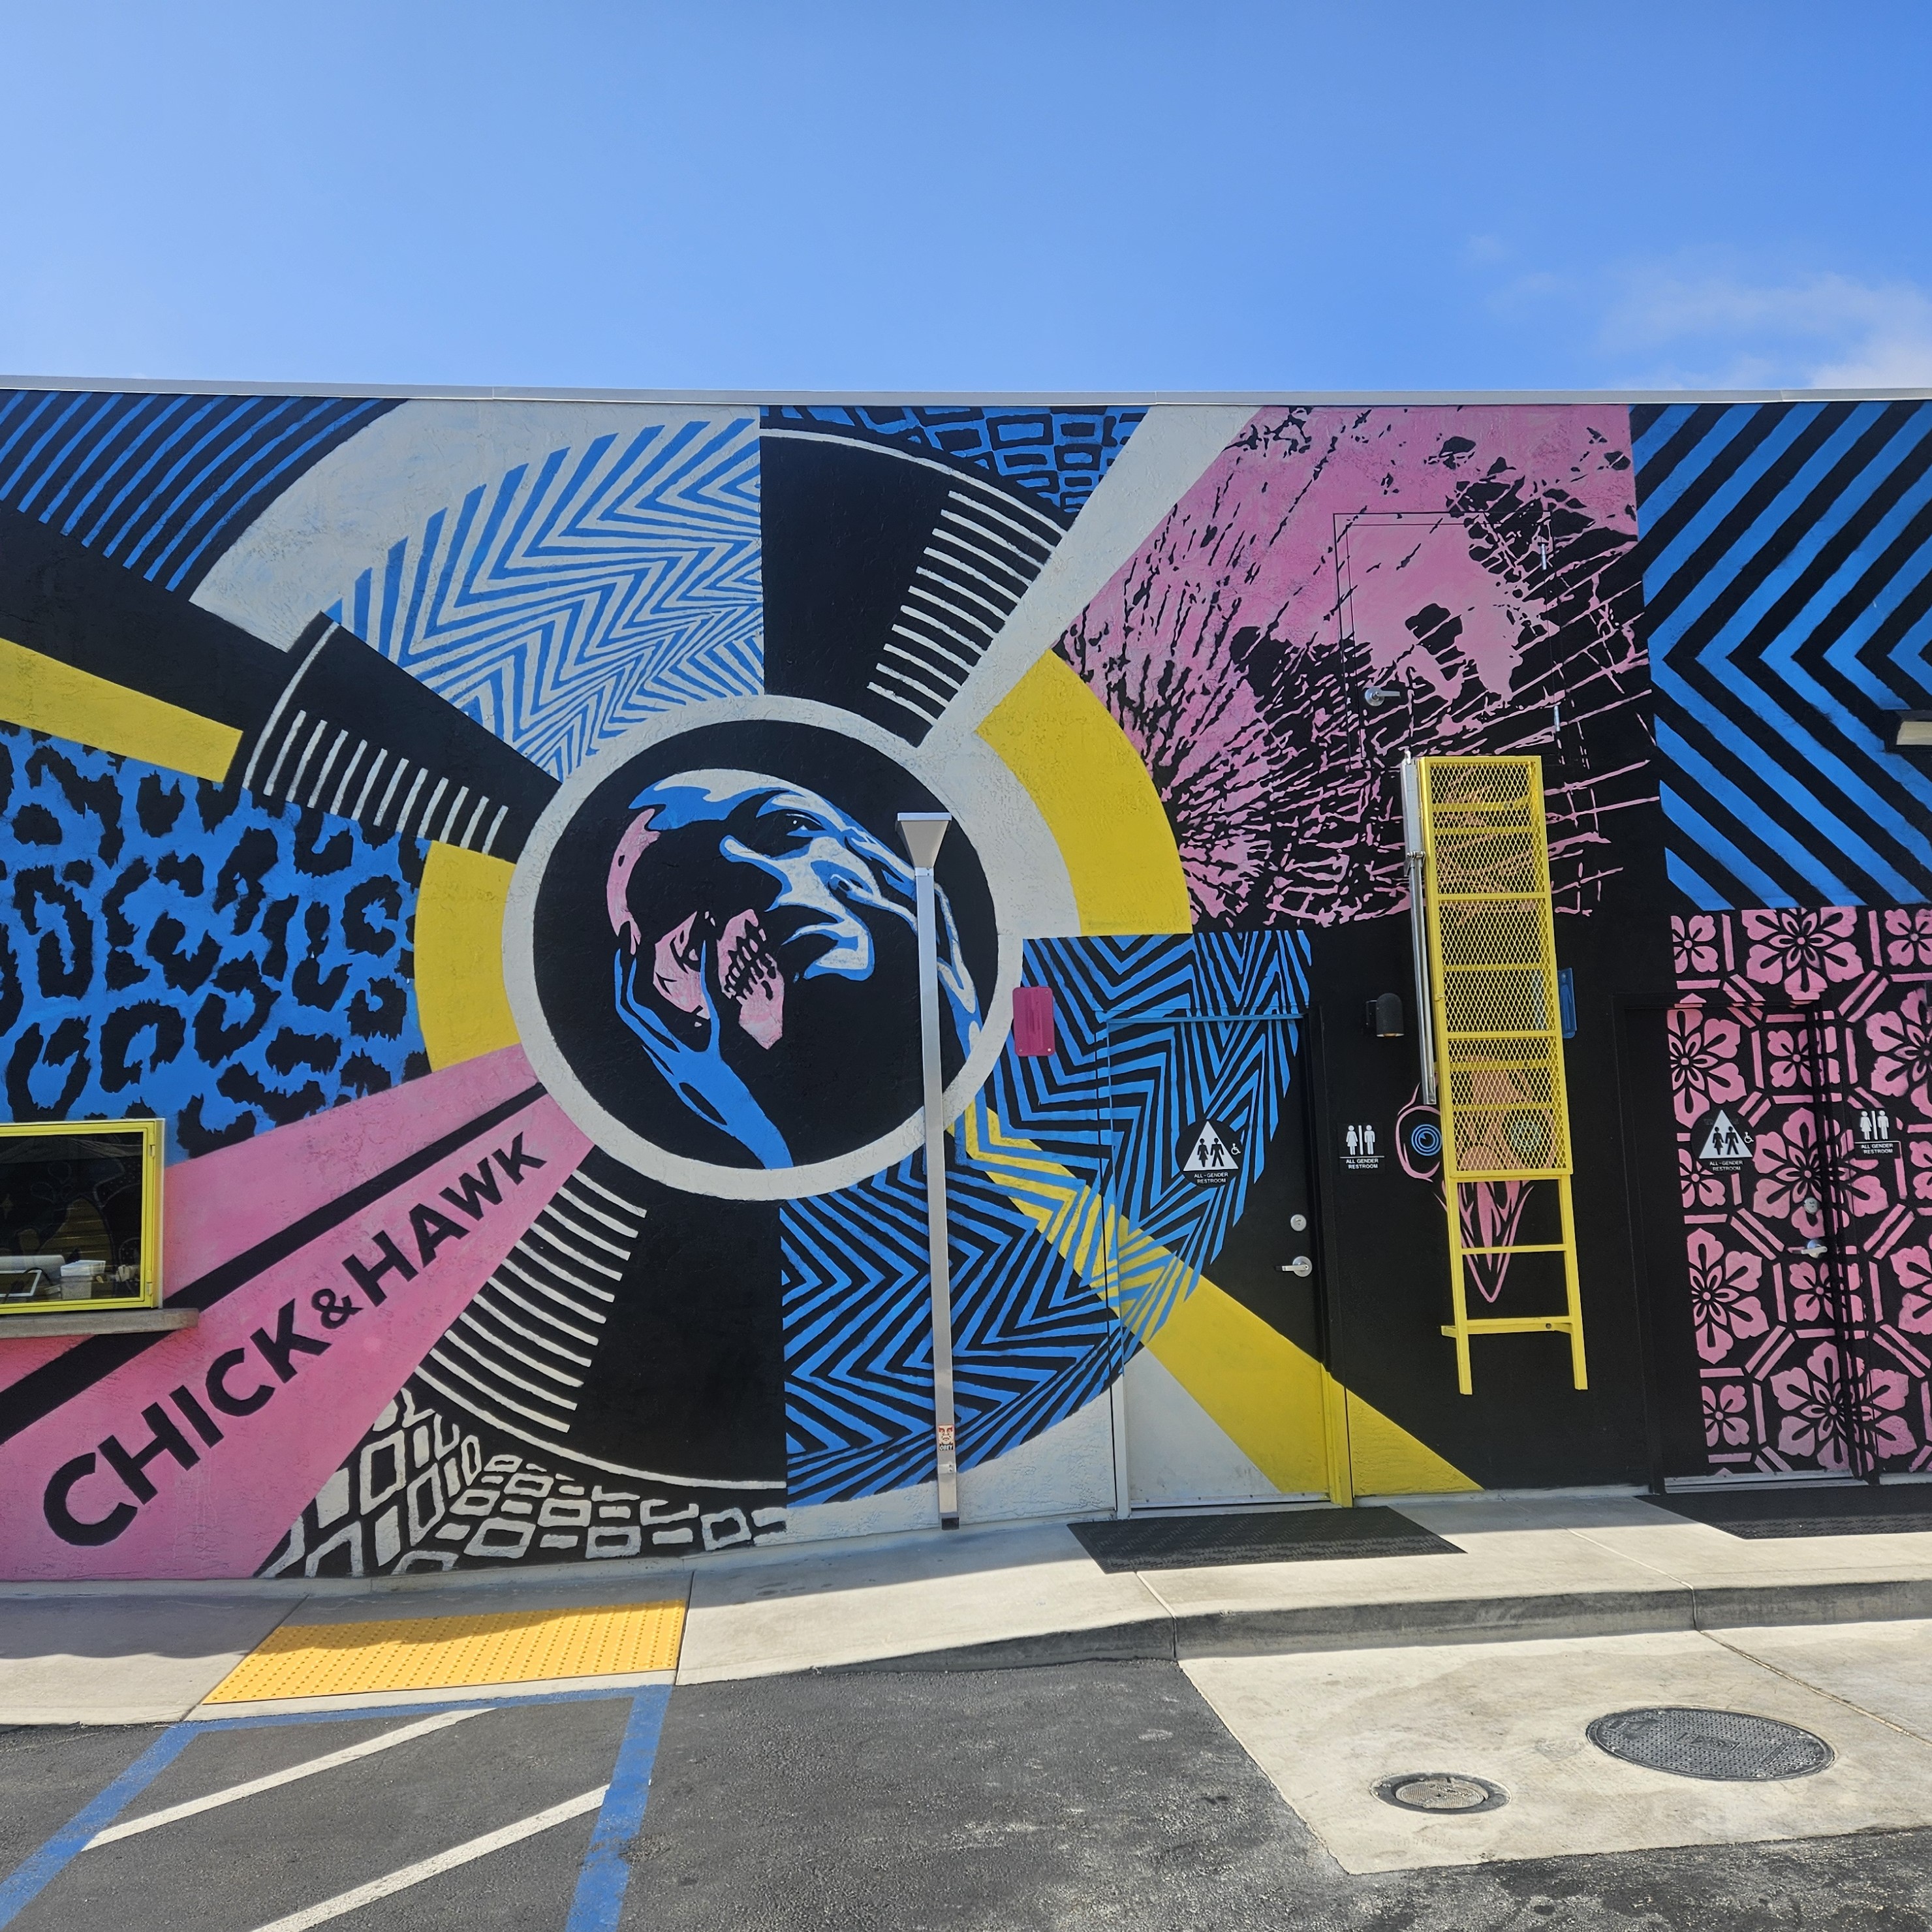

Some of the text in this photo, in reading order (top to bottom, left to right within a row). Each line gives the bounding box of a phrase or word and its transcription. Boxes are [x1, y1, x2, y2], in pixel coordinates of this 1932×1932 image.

[44, 1131, 546, 1546] CHICK & HAWK
